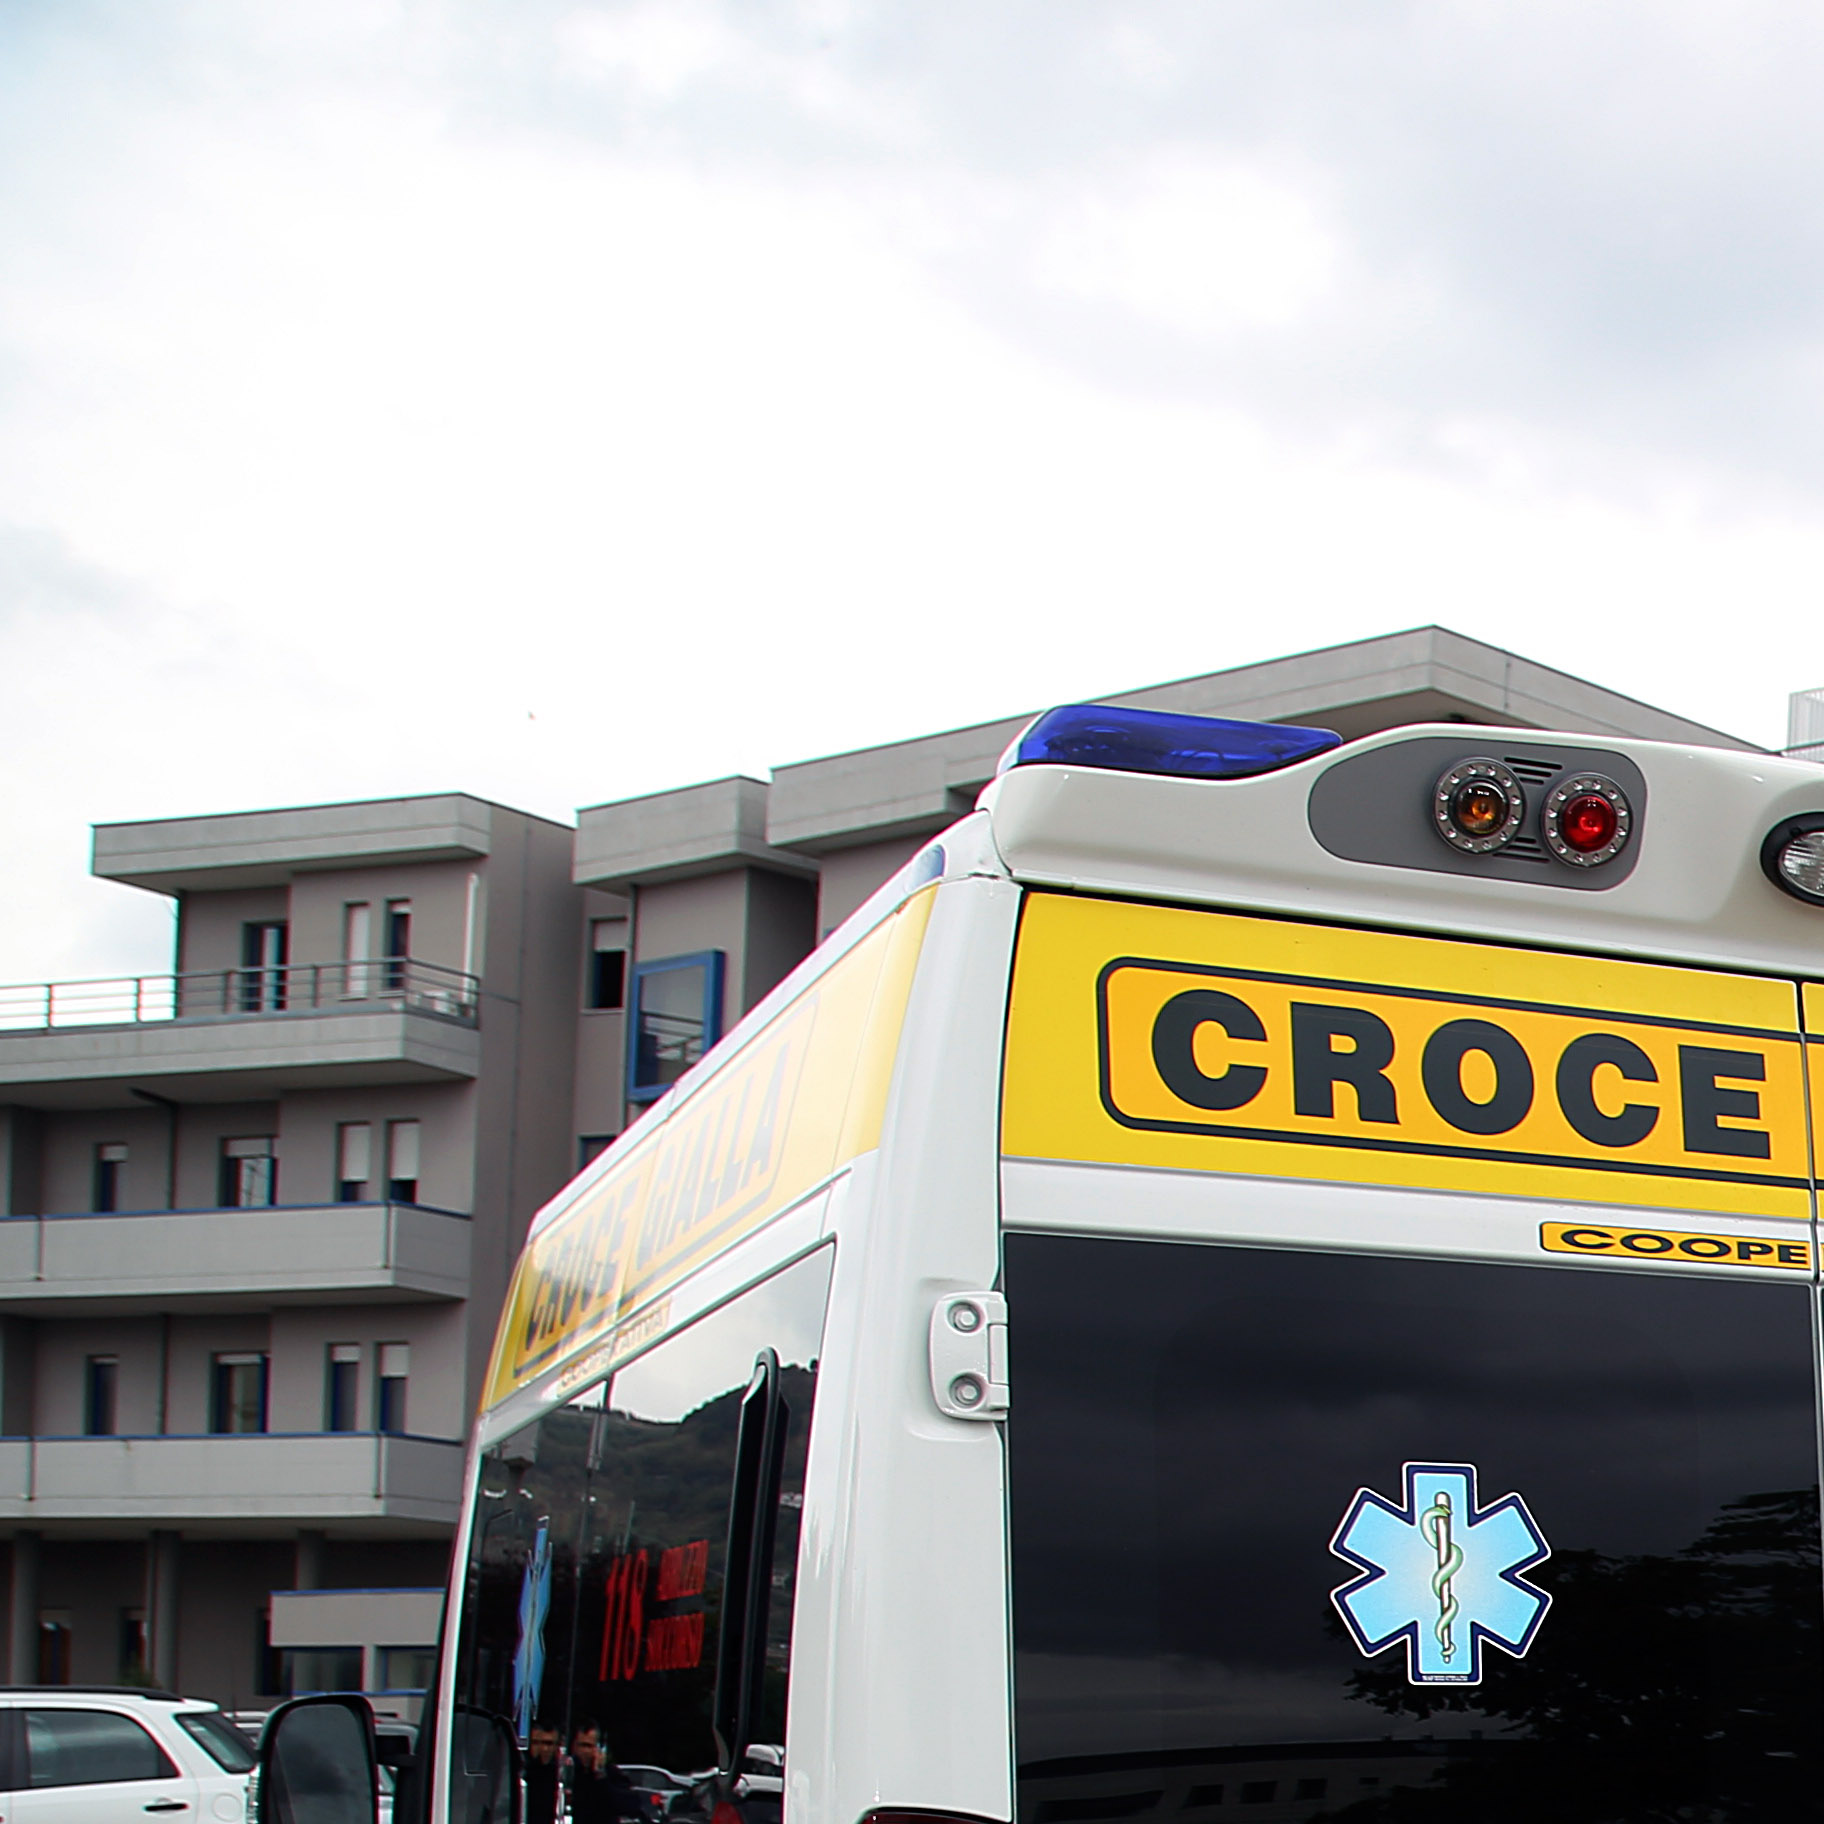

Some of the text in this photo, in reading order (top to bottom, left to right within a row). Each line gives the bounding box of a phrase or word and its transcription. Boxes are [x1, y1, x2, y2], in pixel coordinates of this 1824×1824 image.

[636, 1038, 792, 1273] GIALLA
[1152, 989, 1769, 1160] CROCE
[599, 1549, 648, 1681] 118
